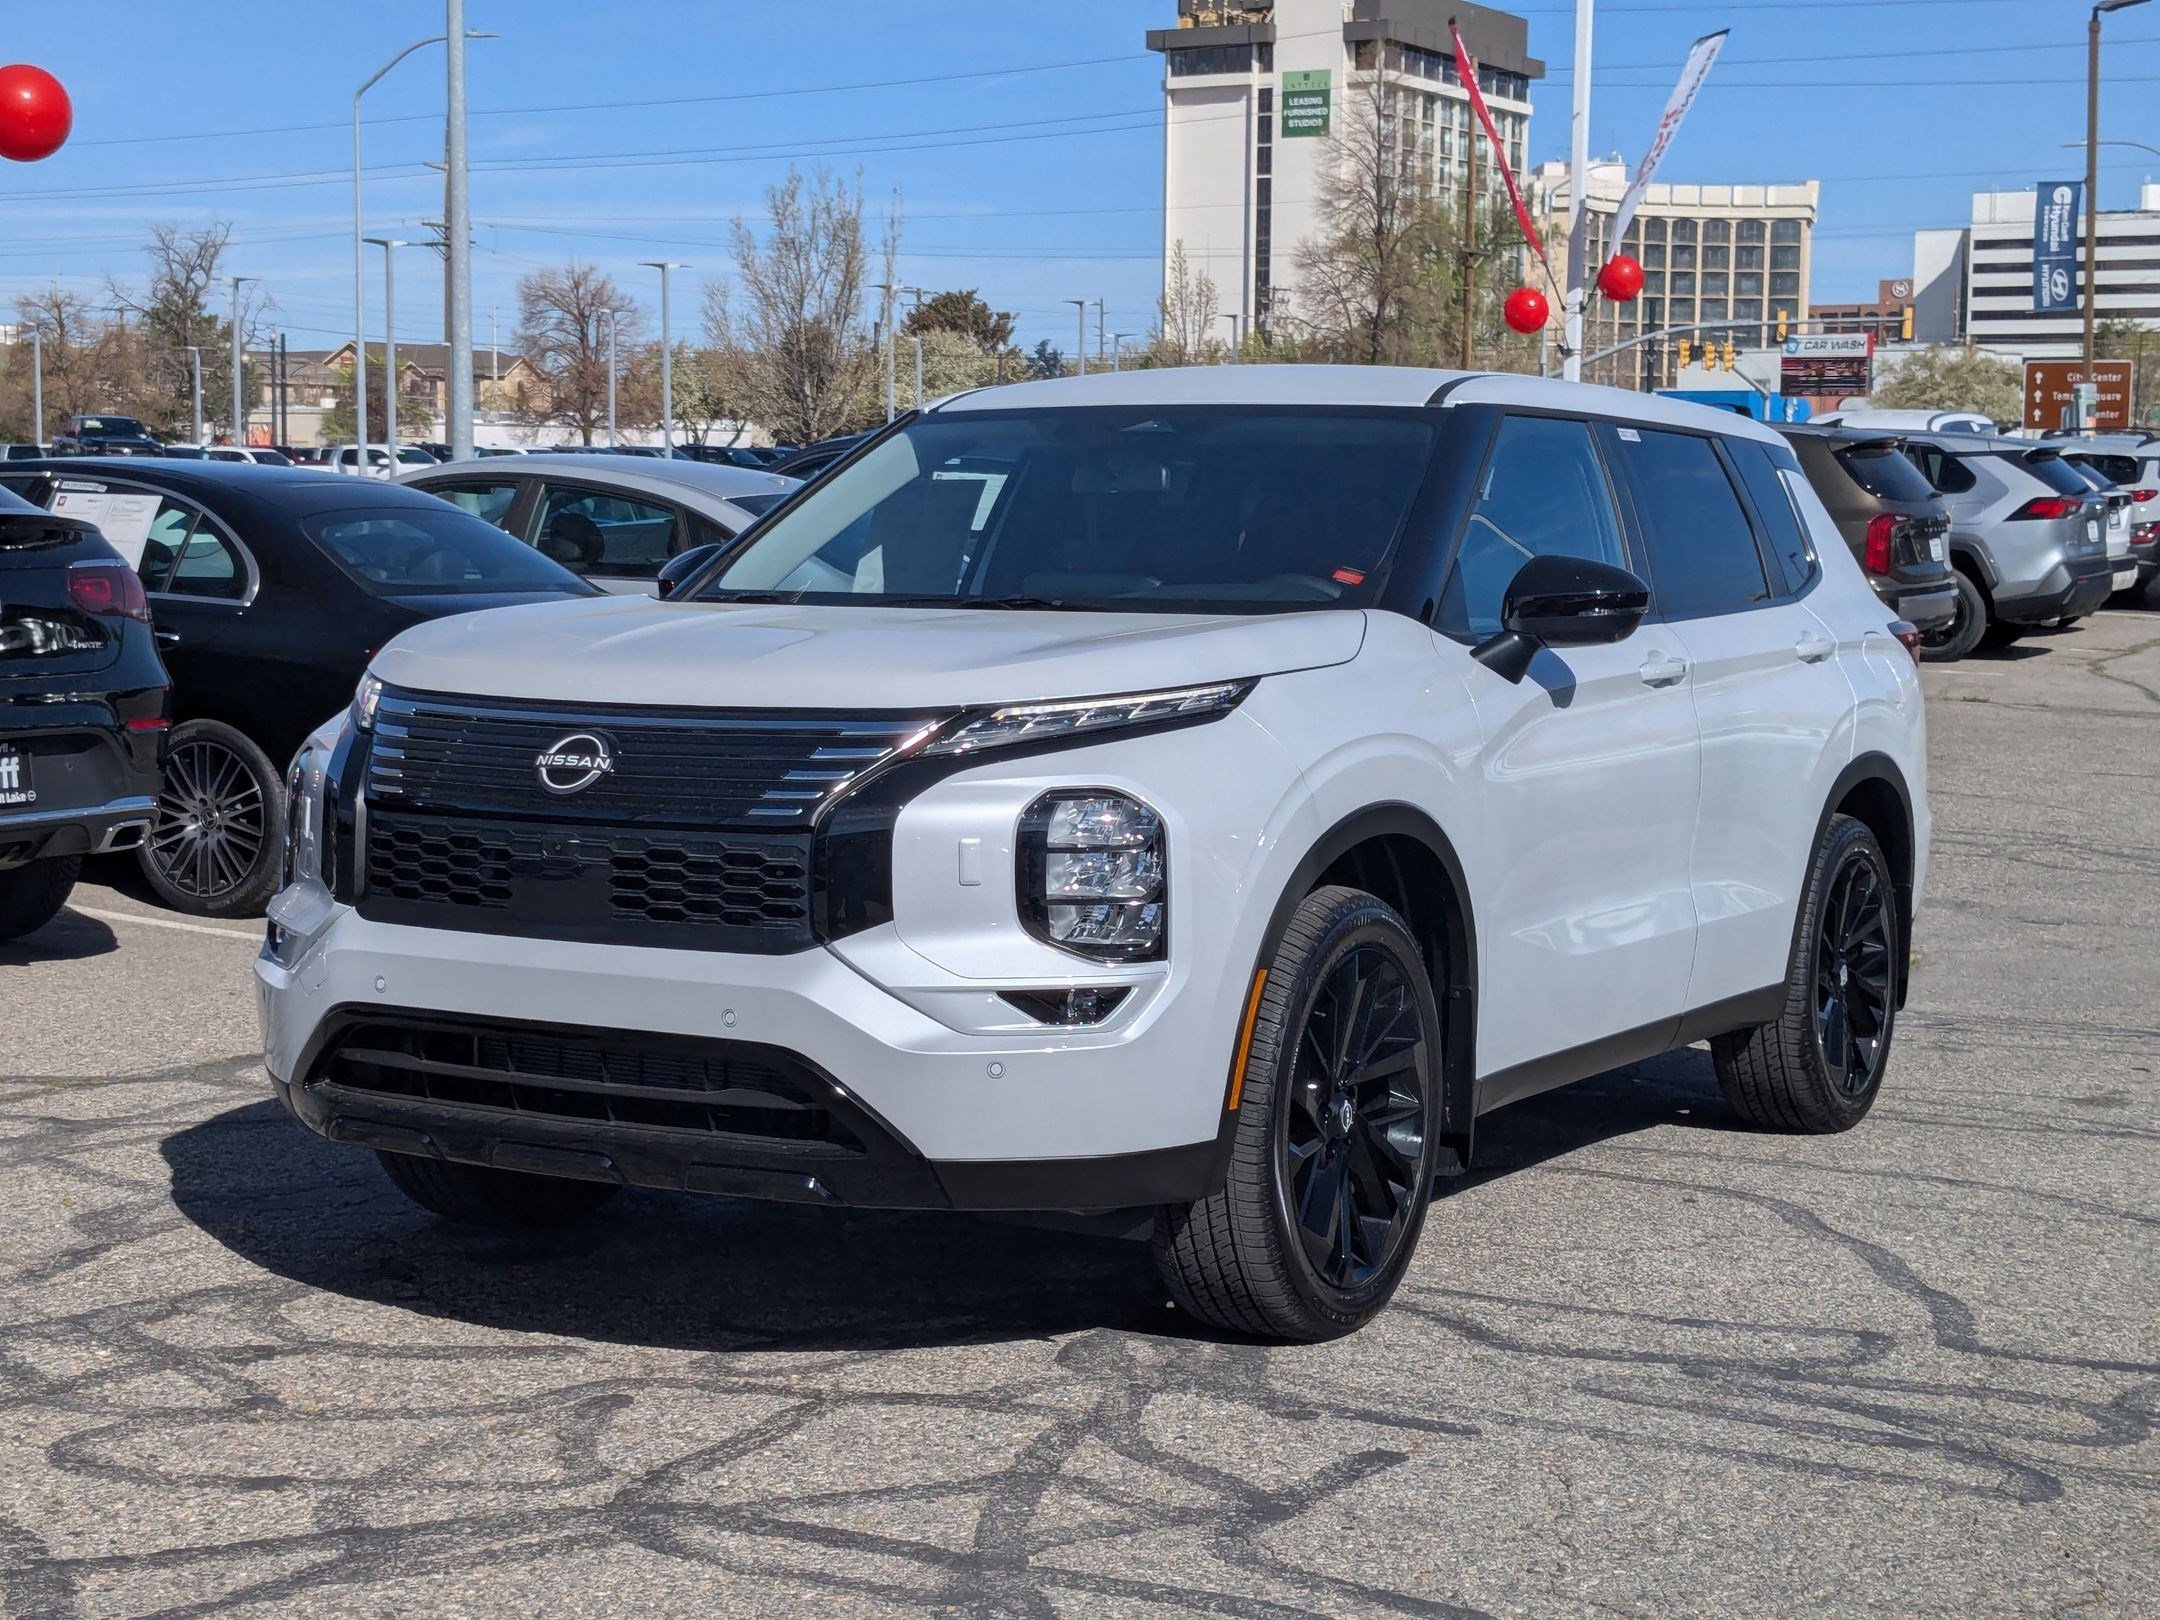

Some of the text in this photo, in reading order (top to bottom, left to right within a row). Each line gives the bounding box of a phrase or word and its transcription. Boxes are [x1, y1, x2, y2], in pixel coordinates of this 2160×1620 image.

[1288, 97, 1324, 106] LEASING
[1283, 107, 1329, 118] FURNISHED
[1288, 118, 1324, 128] STUDIOS
[2050, 205, 2062, 252] Hyundai
[2041, 264, 2050, 307] HYUNDAI
[1804, 341, 1828, 350] CAR
[1830, 340, 1866, 350] WASH
[2091, 372, 2122, 382] Center
[2095, 393, 2122, 402] quare
[2095, 410, 2120, 419] enter
[536, 754, 611, 770] NISSAN
